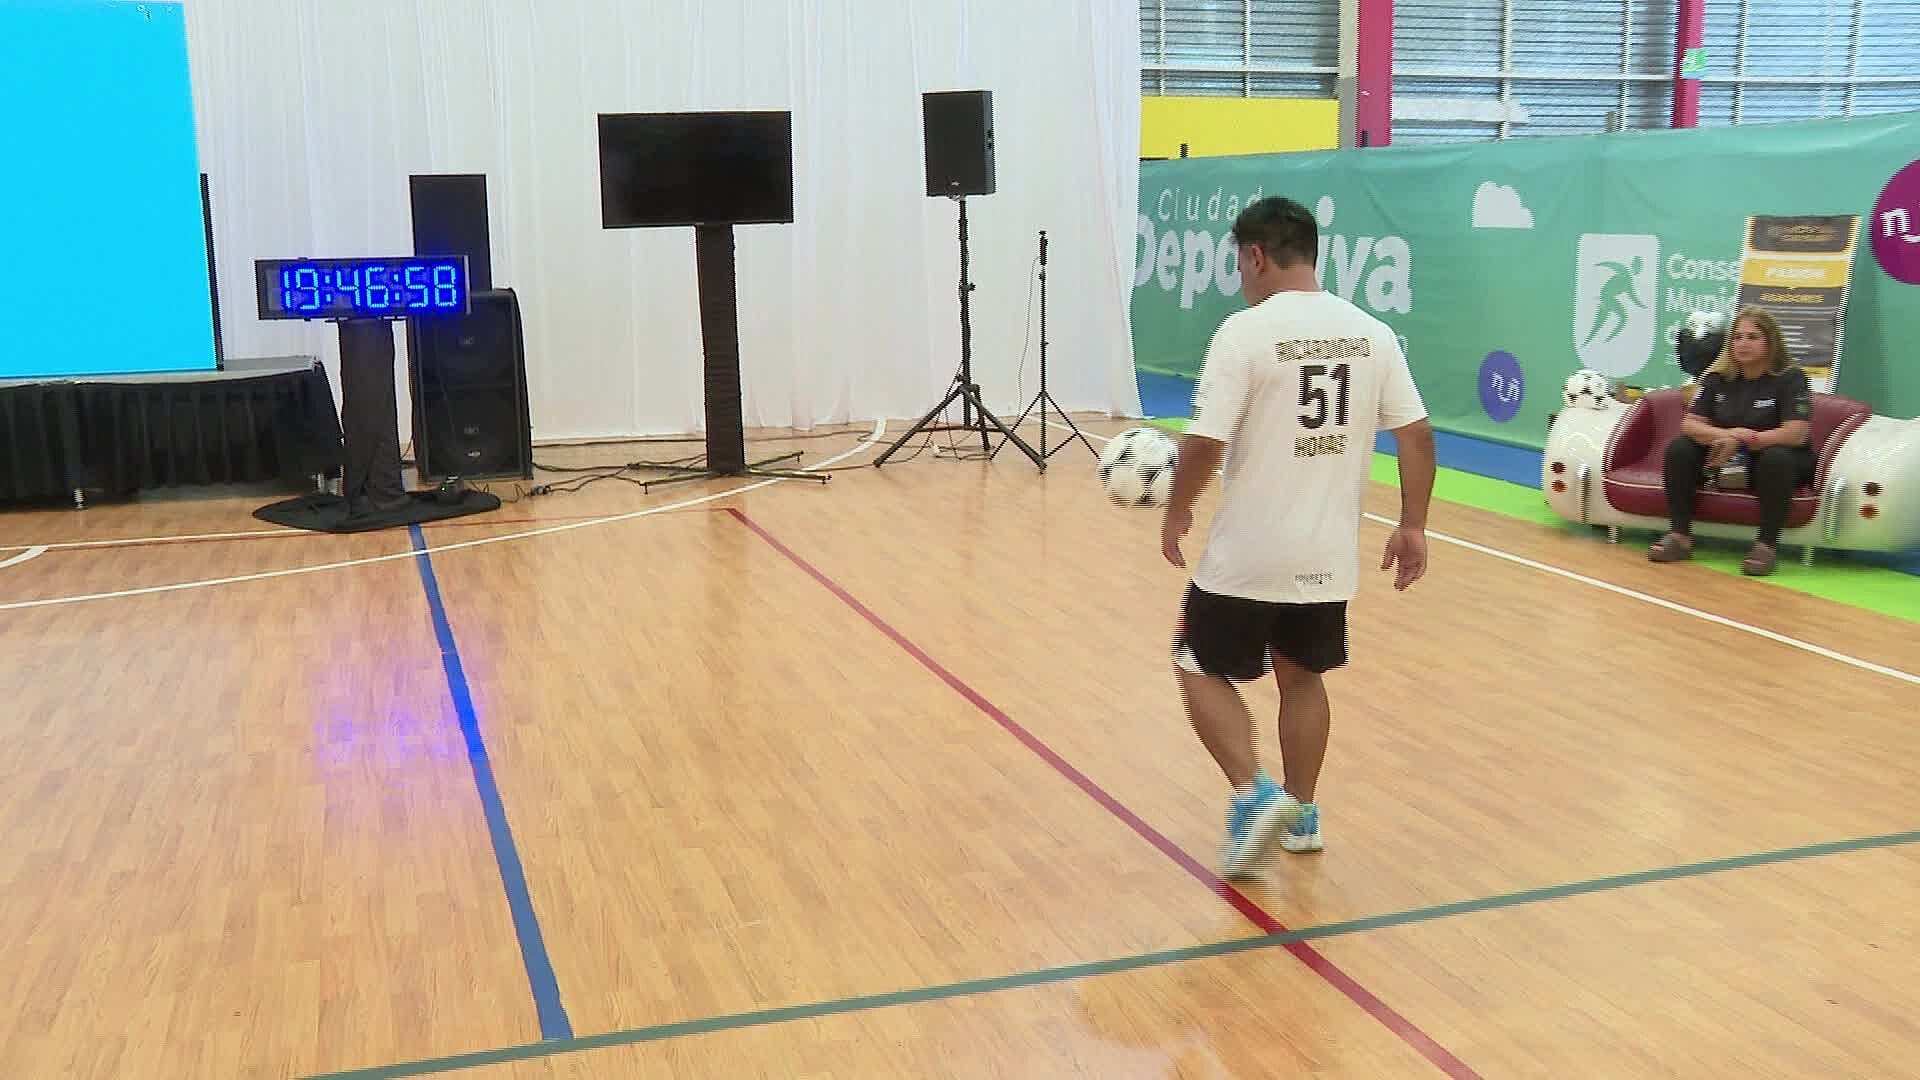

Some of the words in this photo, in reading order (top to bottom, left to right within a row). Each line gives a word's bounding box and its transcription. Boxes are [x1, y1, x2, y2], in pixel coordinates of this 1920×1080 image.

[1135, 196, 1413, 314] Depoiva
[1666, 253, 1738, 281] Conse
[283, 264, 457, 310] 19:46:58
[1664, 288, 1736, 316] Munic
[1275, 336, 1371, 362] RICARDINHO
[1298, 363, 1350, 429] 51
[1293, 433, 1347, 457] HORAS
